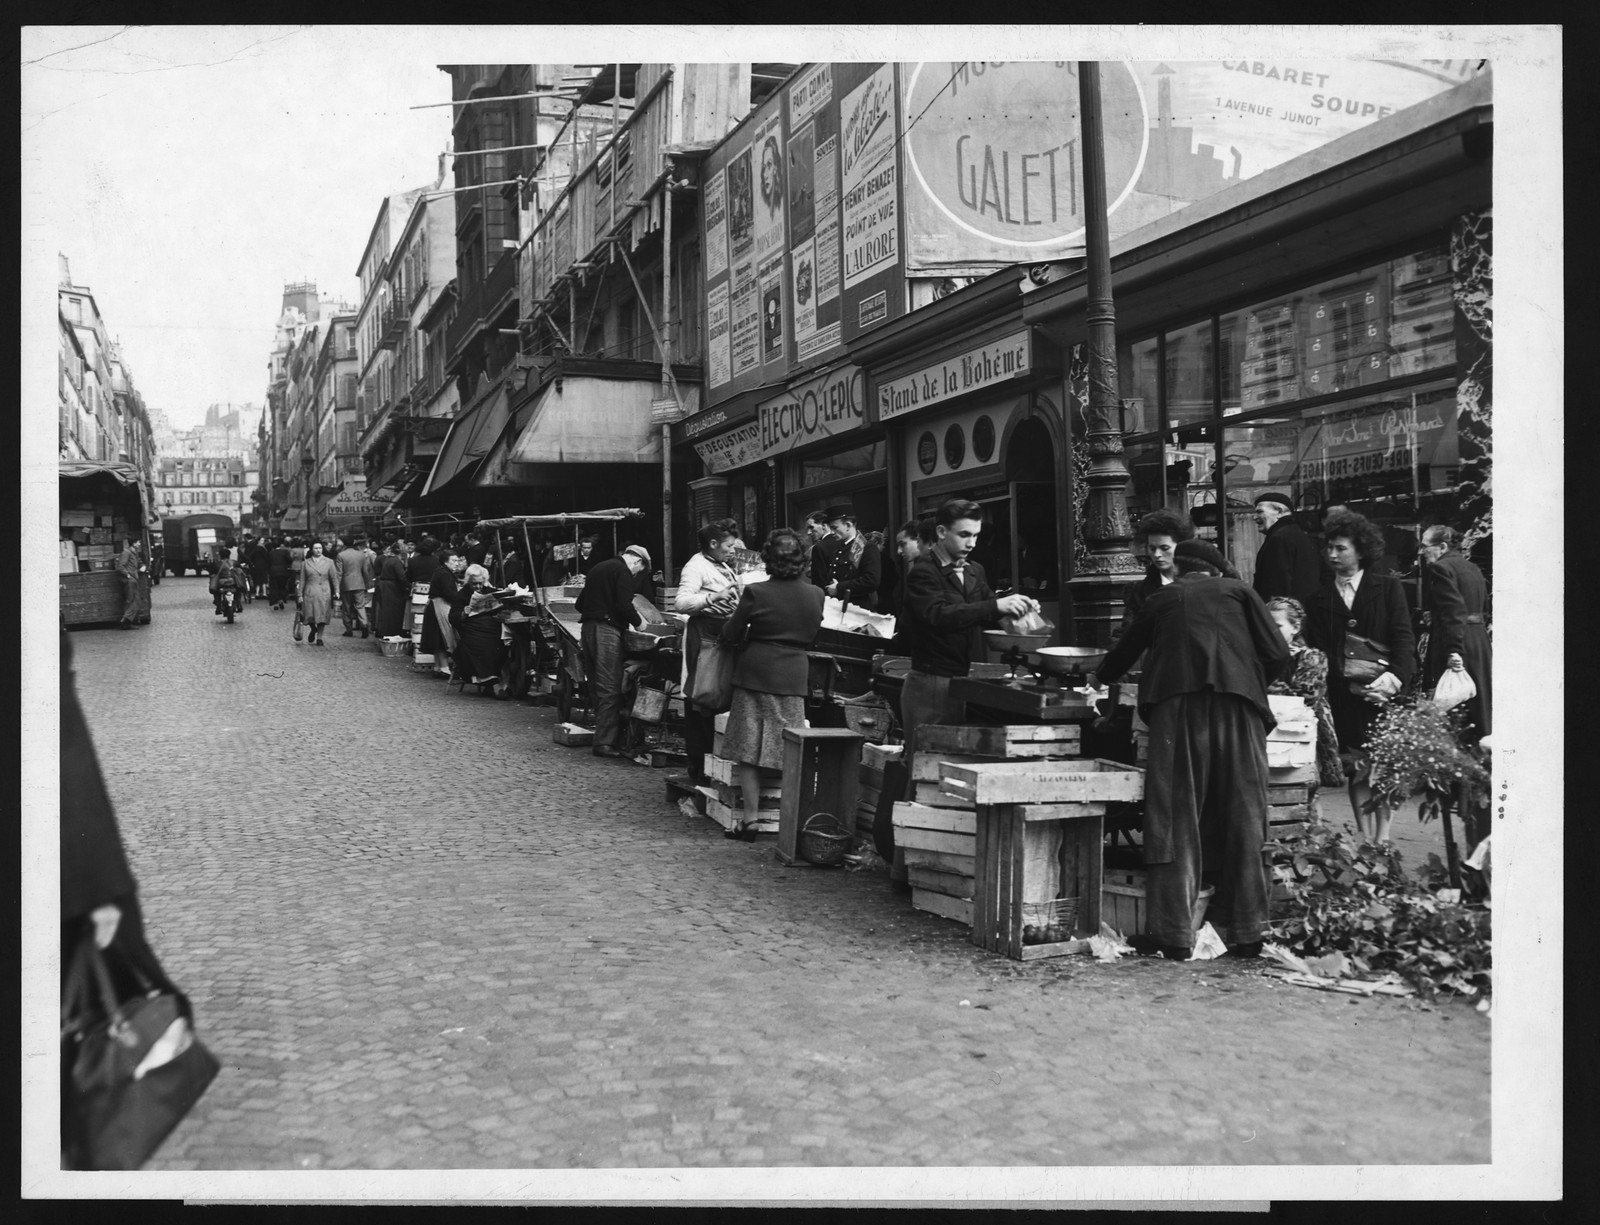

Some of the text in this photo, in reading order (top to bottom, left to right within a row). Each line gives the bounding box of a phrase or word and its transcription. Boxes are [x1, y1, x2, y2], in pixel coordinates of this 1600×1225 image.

[809, 64, 831, 98] COMMU
[1221, 60, 1330, 89] CABARET
[1224, 99, 1273, 118] AVENUE
[1280, 111, 1322, 127] JUNOT
[1310, 93, 1400, 120] SOUPE
[845, 184, 866, 212] HENRY
[867, 165, 895, 198] BENAZET
[956, 133, 1077, 226] GALETT
[868, 212, 877, 229] DE
[878, 200, 894, 222] VUE
[845, 227, 896, 275] L'AURORE
[881, 378, 919, 418] Stand
[922, 373, 939, 401] de
[943, 366, 959, 395] la
